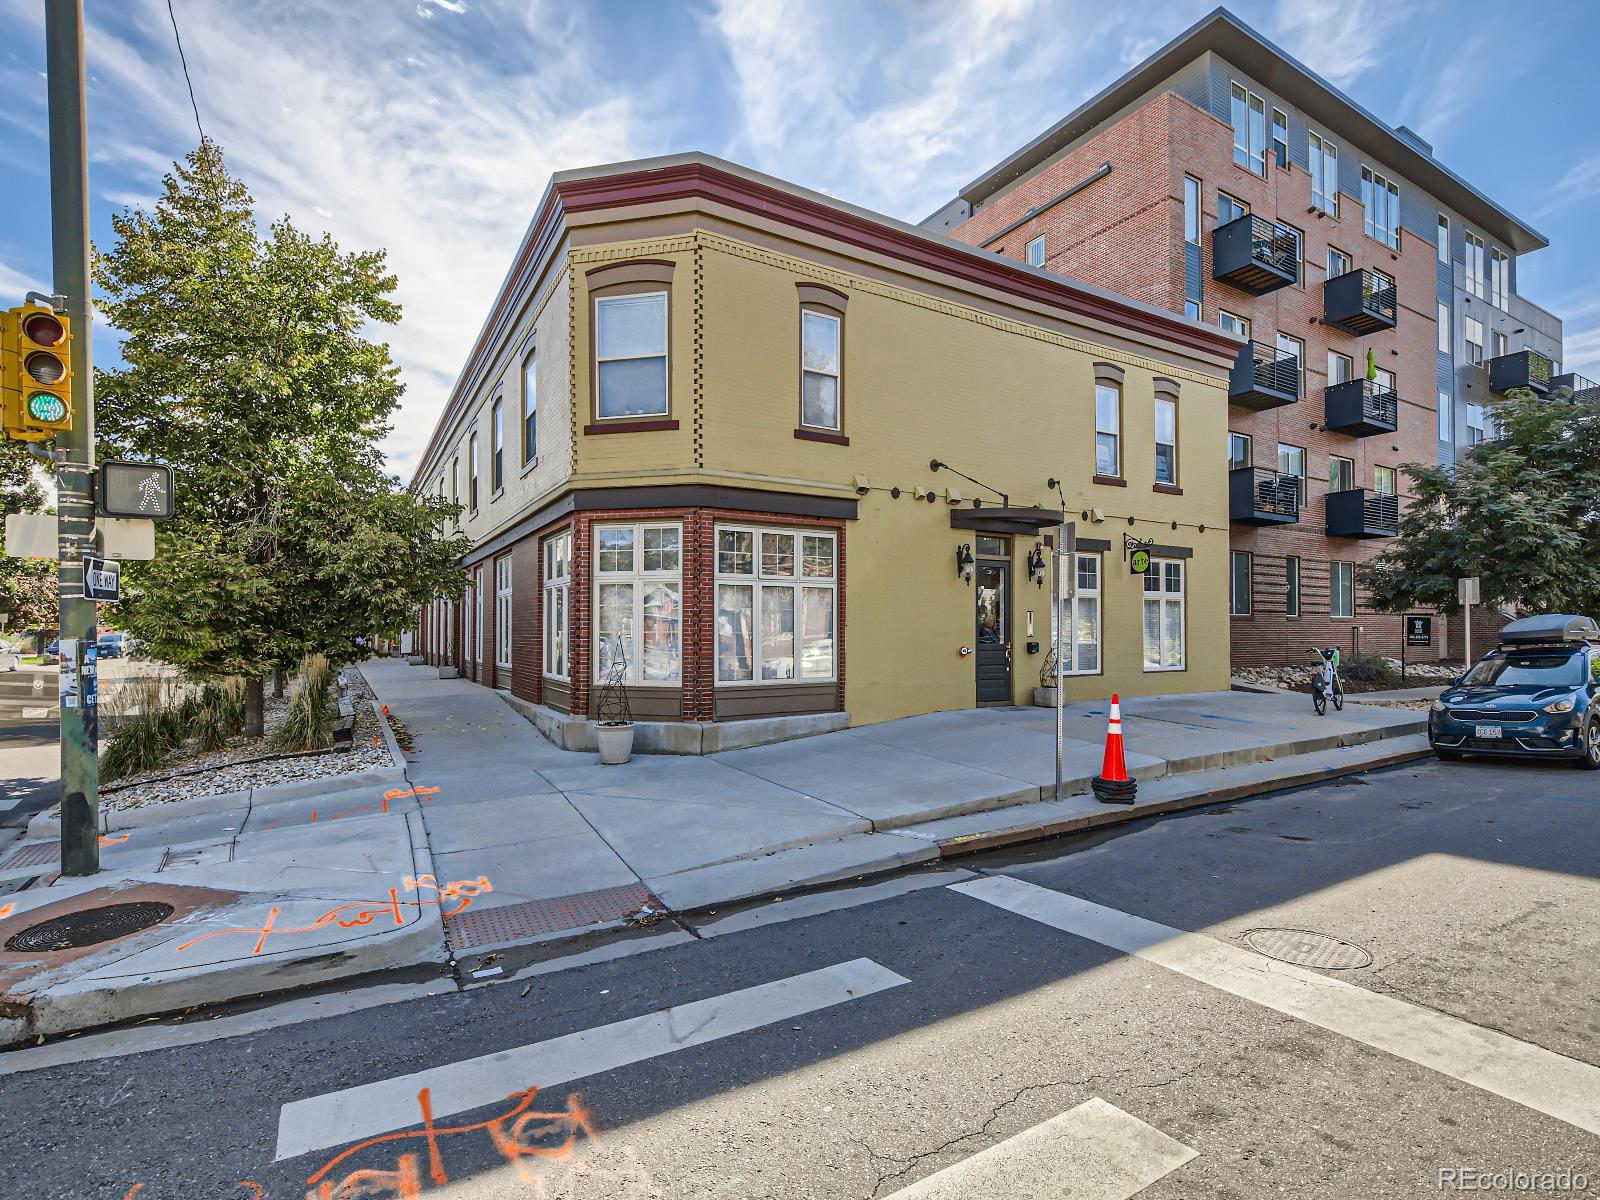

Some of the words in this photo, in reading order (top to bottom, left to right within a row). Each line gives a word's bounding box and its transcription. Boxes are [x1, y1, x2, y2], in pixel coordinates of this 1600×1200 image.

[1132, 558, 1149, 566] arte
[93, 571, 103, 588] ONE
[104, 573, 116, 589] WAY
